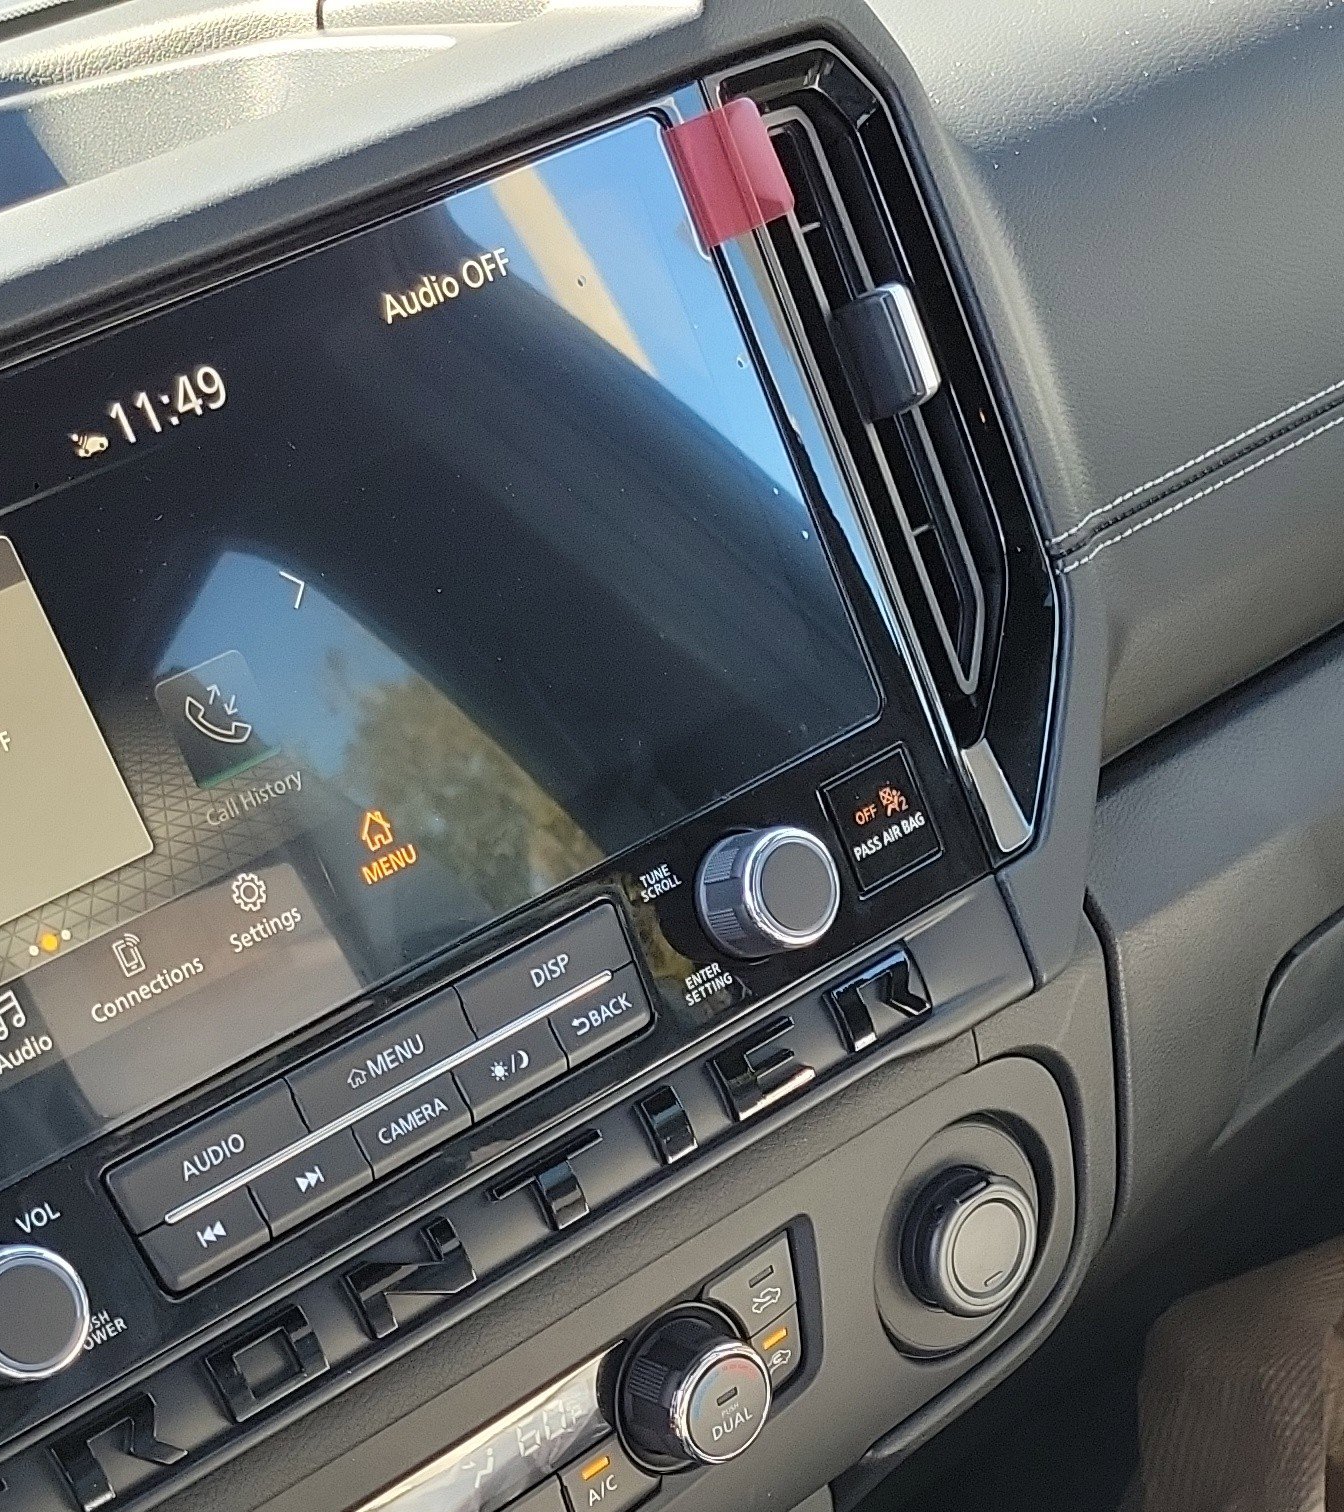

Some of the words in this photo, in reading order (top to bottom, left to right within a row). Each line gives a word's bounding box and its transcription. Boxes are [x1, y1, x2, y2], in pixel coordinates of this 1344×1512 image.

[383, 274, 460, 325] Audio
[461, 247, 511, 289] OFF
[109, 365, 227, 445] 11:49
[205, 796, 240, 828] Call
[240, 768, 304, 814] History
[855, 805, 878, 825] OFF
[853, 839, 882, 862] PASS
[882, 825, 903, 847] AIR
[901, 811, 926, 836] BAG
[361, 843, 418, 886] MENU
[639, 862, 671, 889] TUNE
[640, 877, 682, 903] SCROLL
[229, 904, 303, 955] Settings
[529, 953, 571, 989] DISP
[685, 961, 721, 990] ENTER
[90, 954, 205, 1025] Connections
[685, 972, 733, 1007] SETTING
[587, 992, 633, 1027] BACK
[365, 1033, 426, 1080] MENU
[377, 1096, 449, 1146] CAMERA
[181, 1133, 246, 1183] AUDIO
[15, 1202, 61, 1236] VOL
[83, 1316, 128, 1350] OWER
[712, 1407, 753, 1441] DUAL
[587, 1475, 619, 1507] A/C
